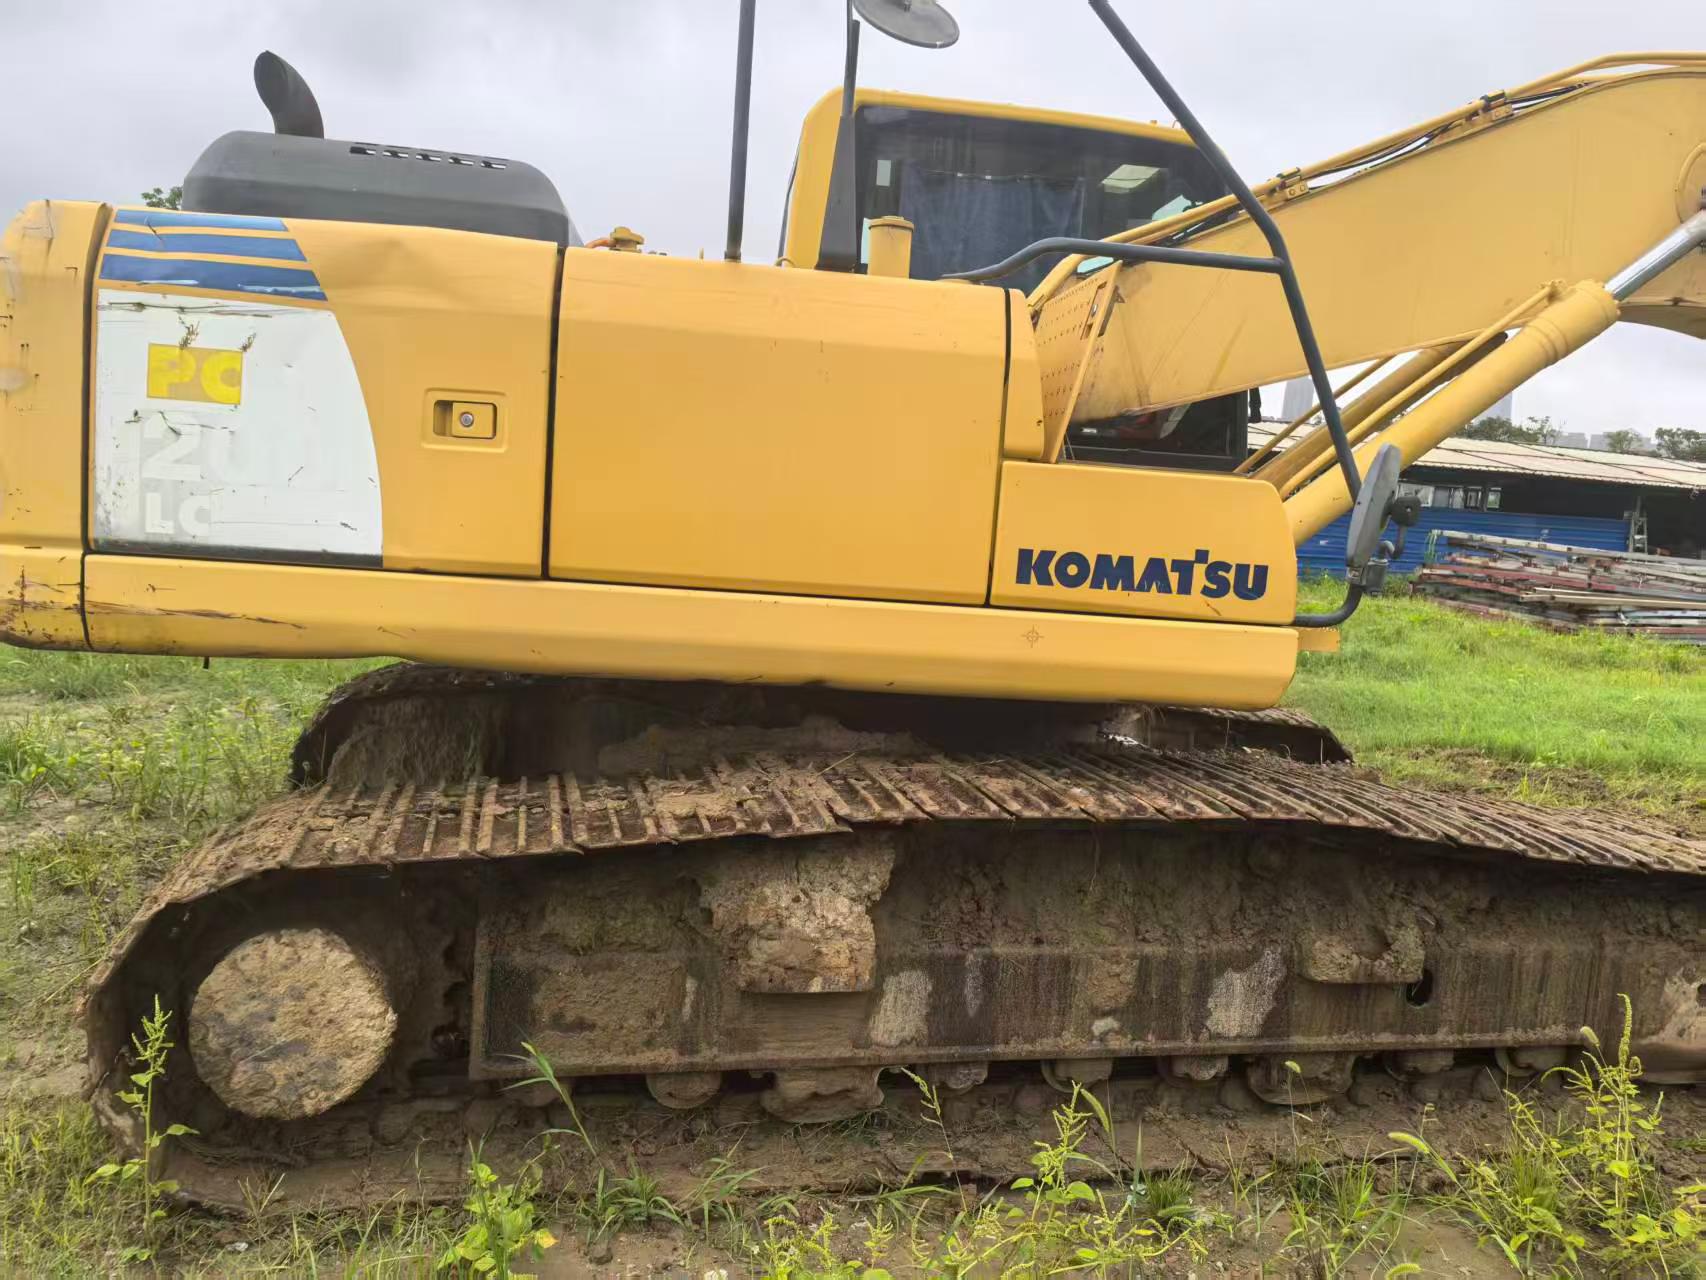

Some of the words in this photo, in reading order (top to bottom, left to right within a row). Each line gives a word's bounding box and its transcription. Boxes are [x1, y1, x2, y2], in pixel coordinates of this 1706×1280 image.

[148, 345, 241, 404] PC
[145, 492, 211, 537] LC
[1016, 548, 1268, 600] KOMATSU
